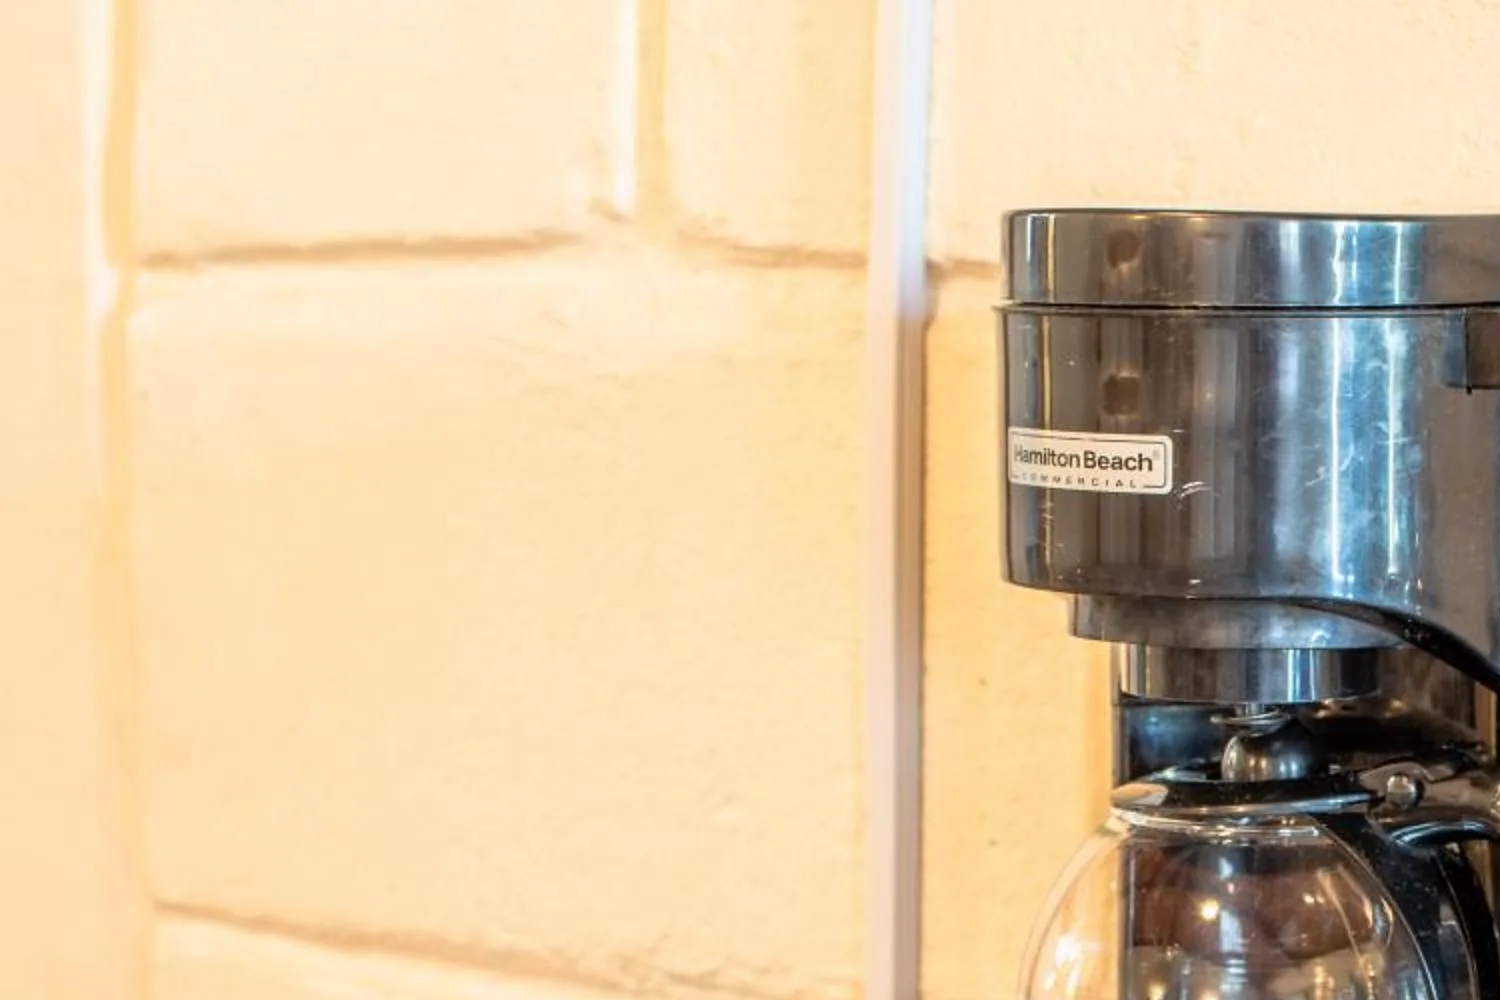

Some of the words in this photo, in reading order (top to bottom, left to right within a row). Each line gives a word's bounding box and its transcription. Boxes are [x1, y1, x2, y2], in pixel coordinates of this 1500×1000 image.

[1014, 444, 1081, 469] Hamilton
[1083, 450, 1153, 473] Beach
[1022, 474, 1137, 489] COMMERCIAL
